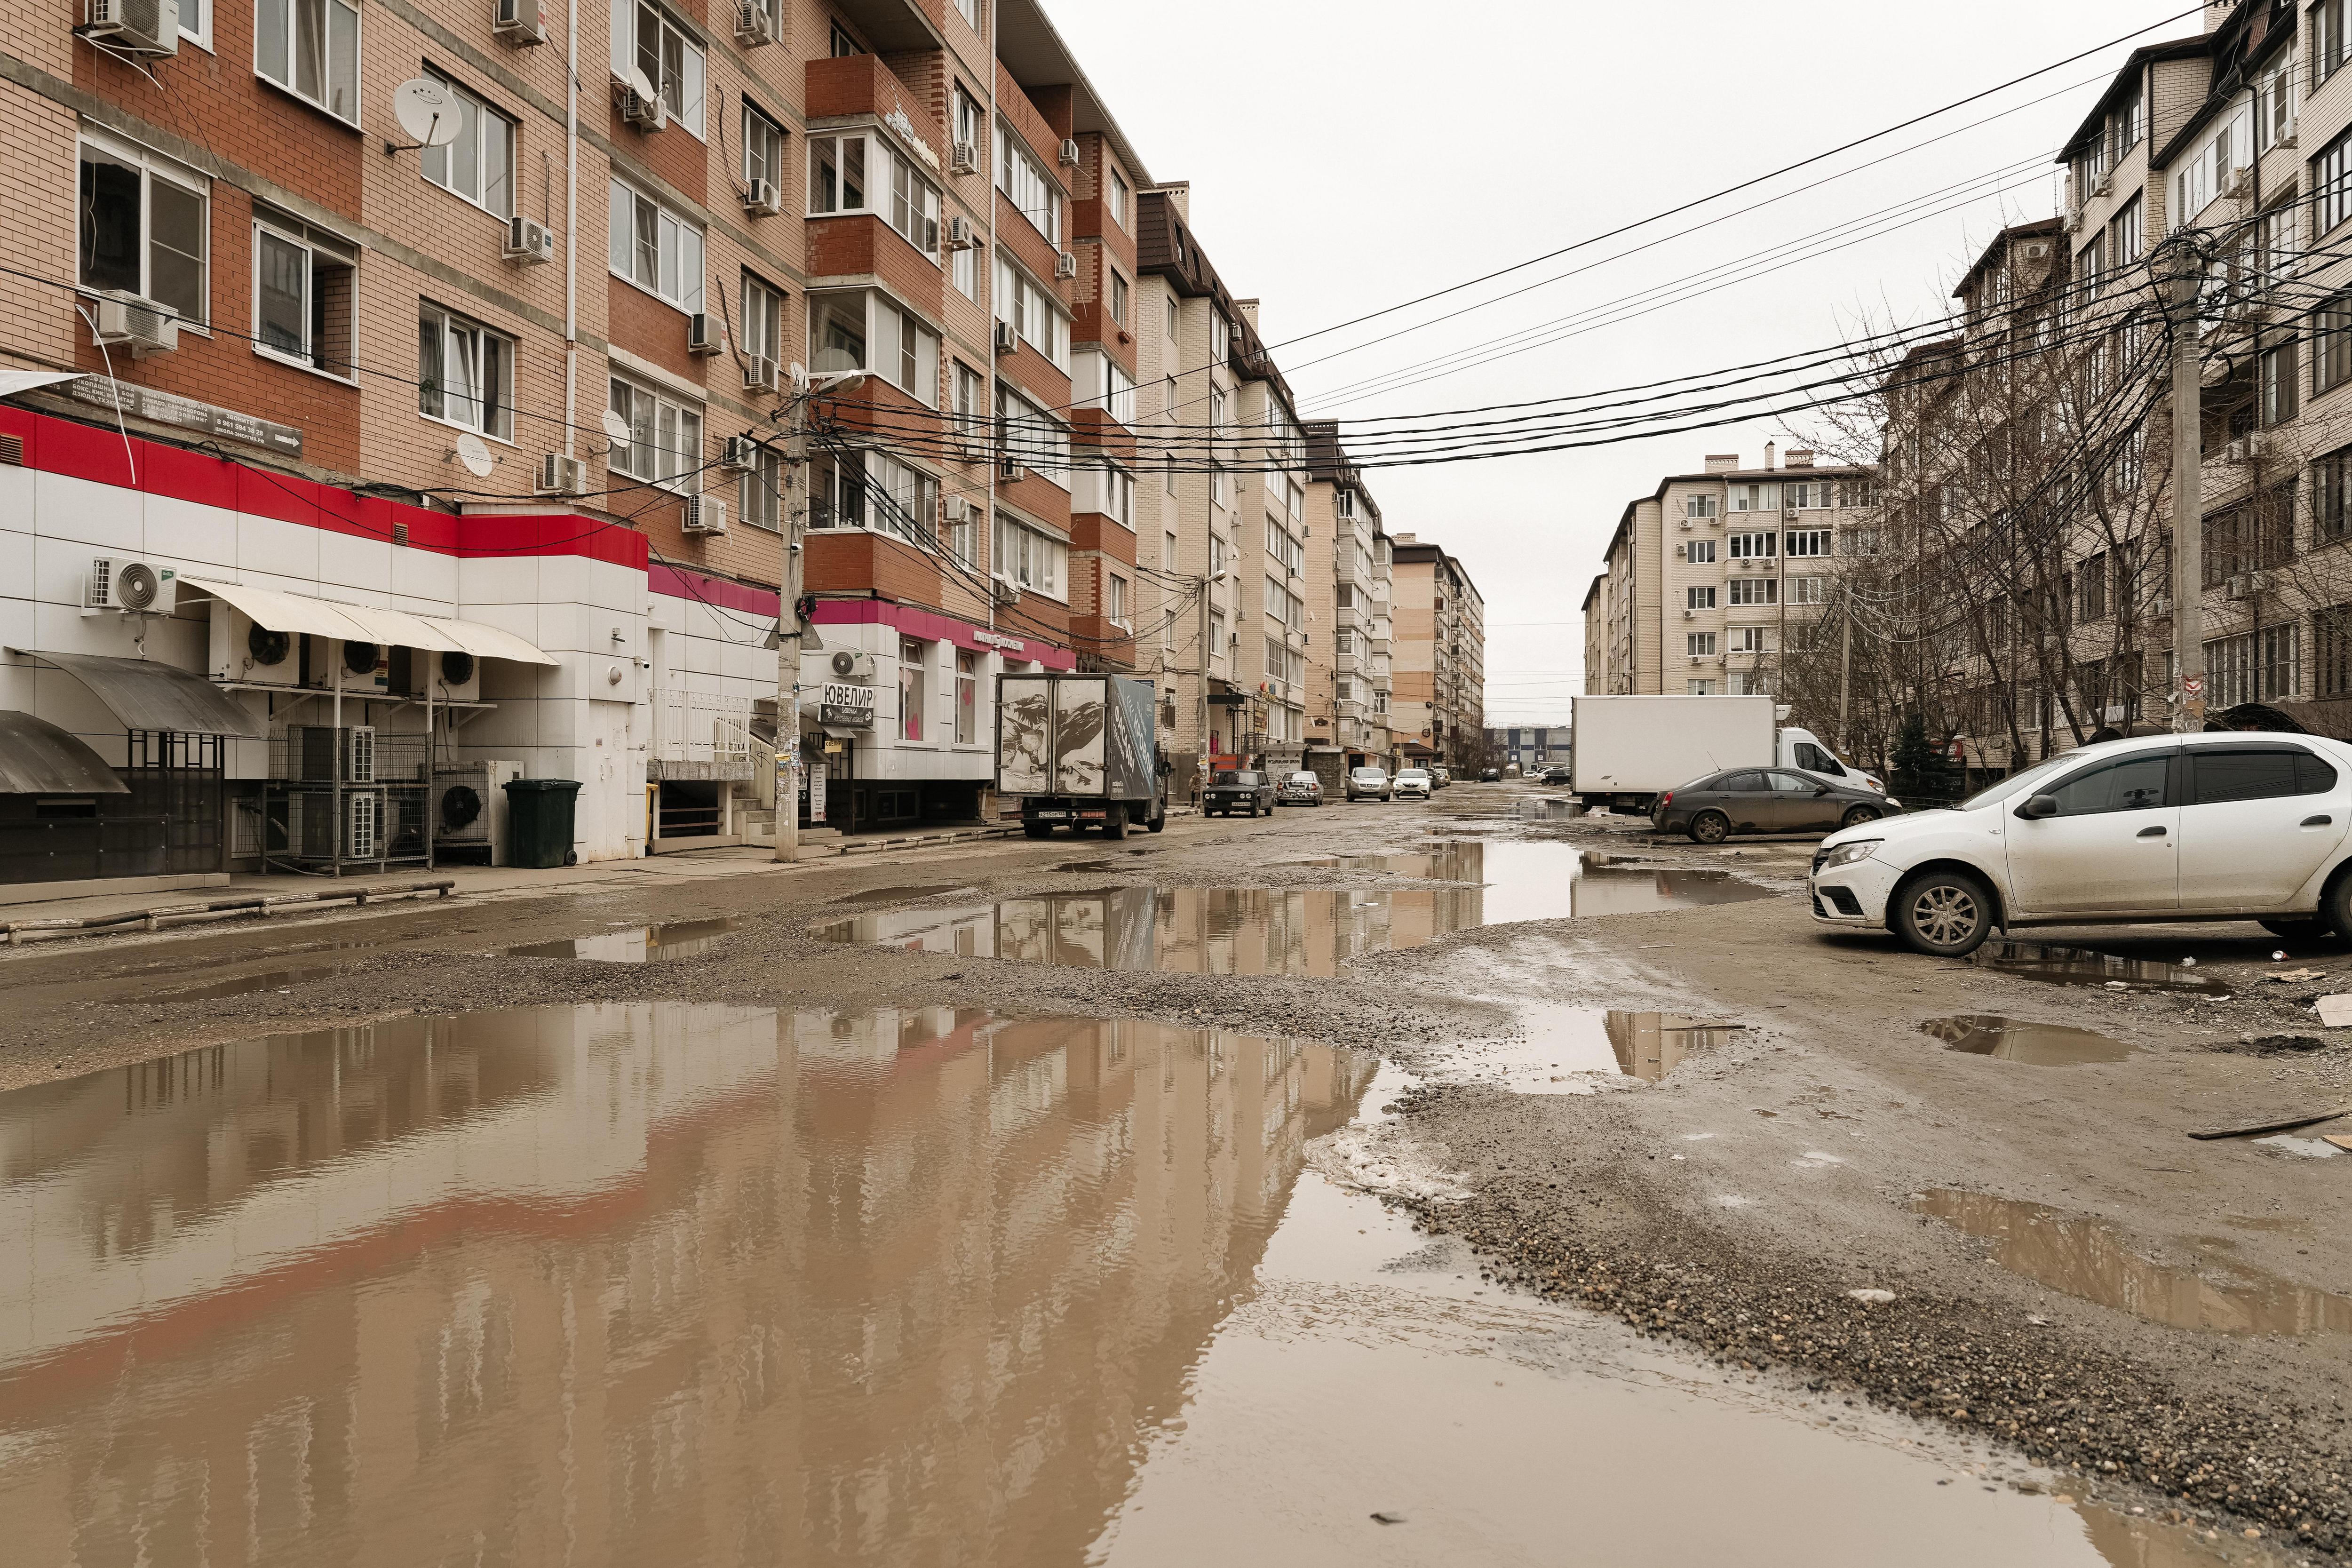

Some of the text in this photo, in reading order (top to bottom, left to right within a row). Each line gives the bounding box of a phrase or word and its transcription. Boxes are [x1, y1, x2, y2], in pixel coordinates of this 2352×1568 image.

[72, 383, 135, 405] БОКС, КИК, МУЙТАЙ
[72, 390, 96, 401] ДЗЮДО,
[121, 390, 135, 398] БОЙ
[167, 403, 208, 418] САМООБОРОНА
[187, 402, 208, 412] КАРАТЭ
[222, 420, 234, 428] 961
[235, 423, 246, 432] 594
[215, 426, 265, 444] ШКОЛА-ЭНЕРГИЯ.РФ
[825, 684, 873, 707] ЮВЕЛИР
[1115, 705, 1135, 773] ФАСАДЫ
[1133, 713, 1153, 779] КРОВЛИ
